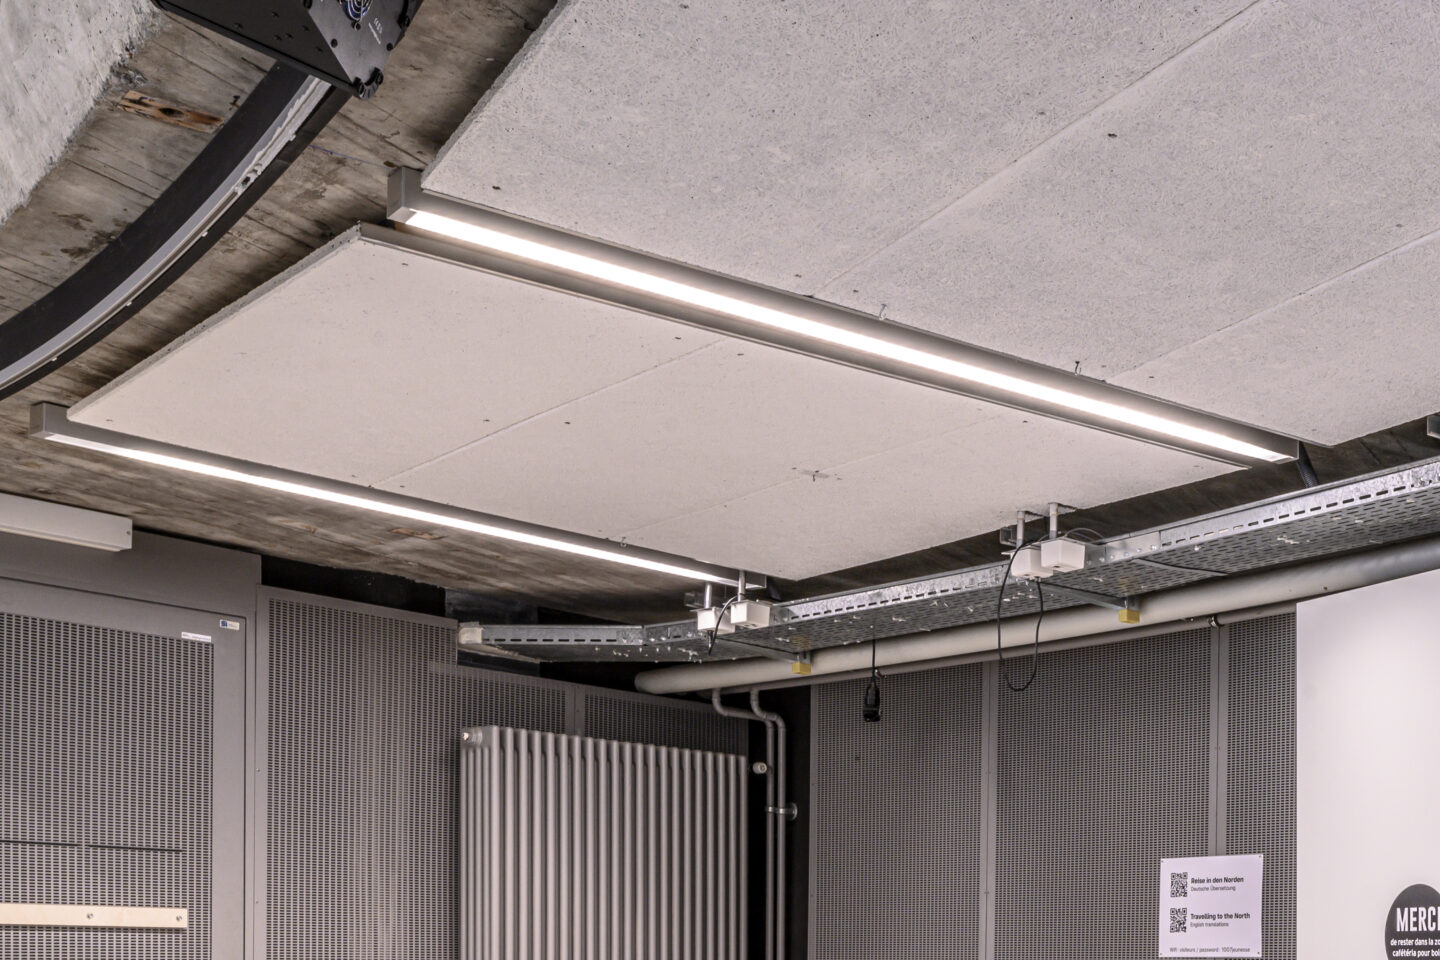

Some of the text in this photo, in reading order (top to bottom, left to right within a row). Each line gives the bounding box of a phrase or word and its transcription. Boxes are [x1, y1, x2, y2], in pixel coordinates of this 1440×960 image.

[1190, 913, 1216, 921] Travelling
[1390, 938, 1397, 946] de
[1397, 938, 1414, 946] rester
[1414, 938, 1428, 946] dans
[1428, 938, 1434, 946] la
[1392, 949, 1417, 957] cafétéria
[1417, 950, 1430, 958] pour
